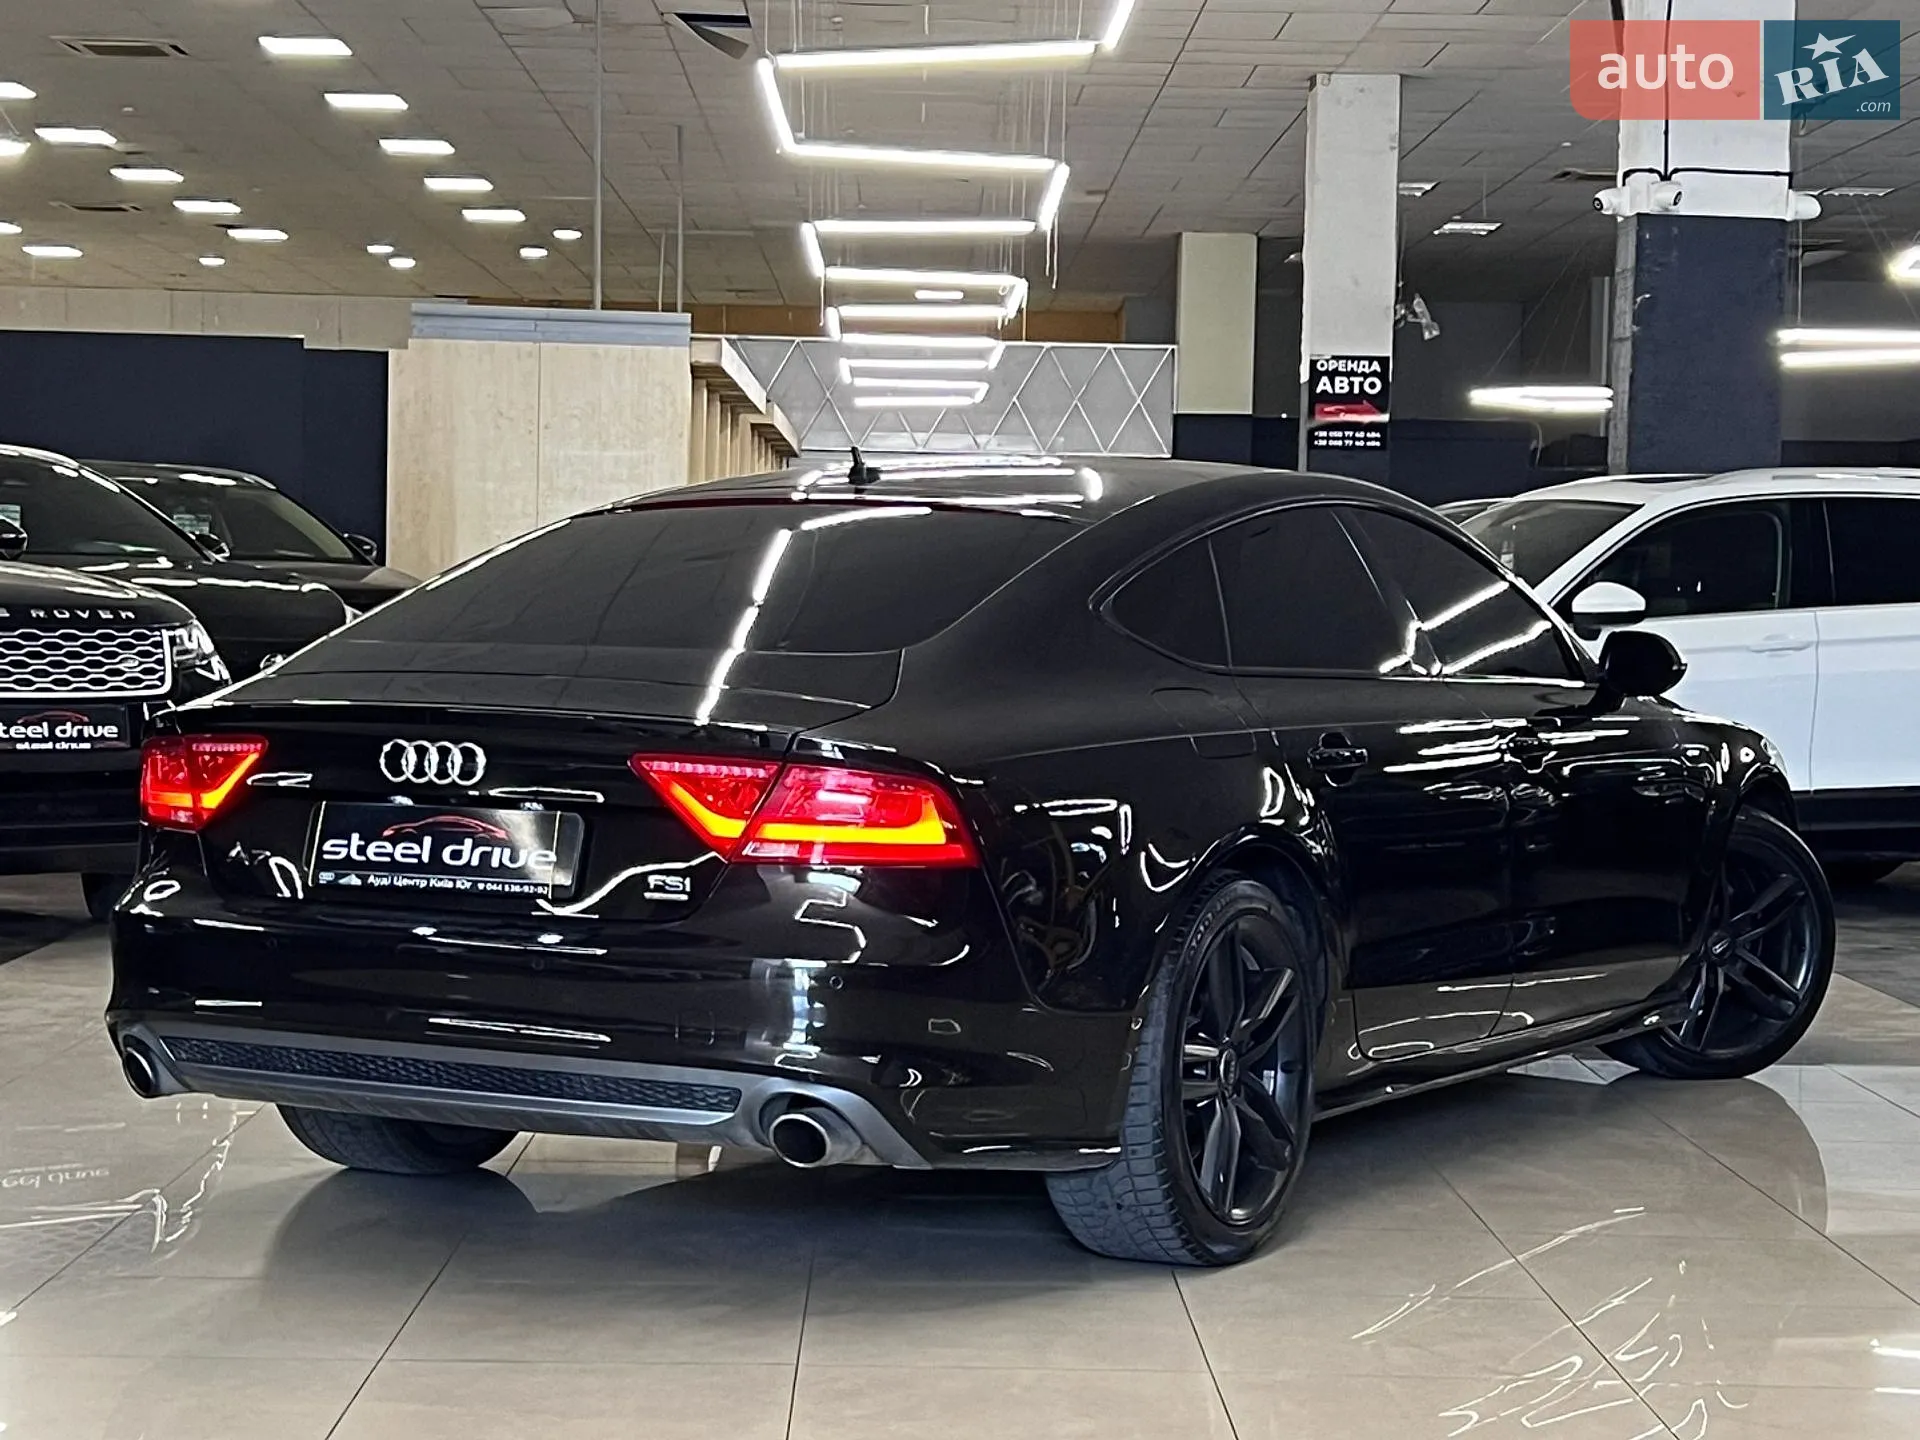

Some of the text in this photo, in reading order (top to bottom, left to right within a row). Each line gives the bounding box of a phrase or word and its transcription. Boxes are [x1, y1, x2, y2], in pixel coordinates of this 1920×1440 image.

[1316, 360, 1382, 373] ОРЕНДА
[1315, 375, 1382, 395] АВТО
[30, 608, 136, 620] ROVER
[0, 721, 119, 739] teel drive
[322, 832, 557, 870] steel drive
